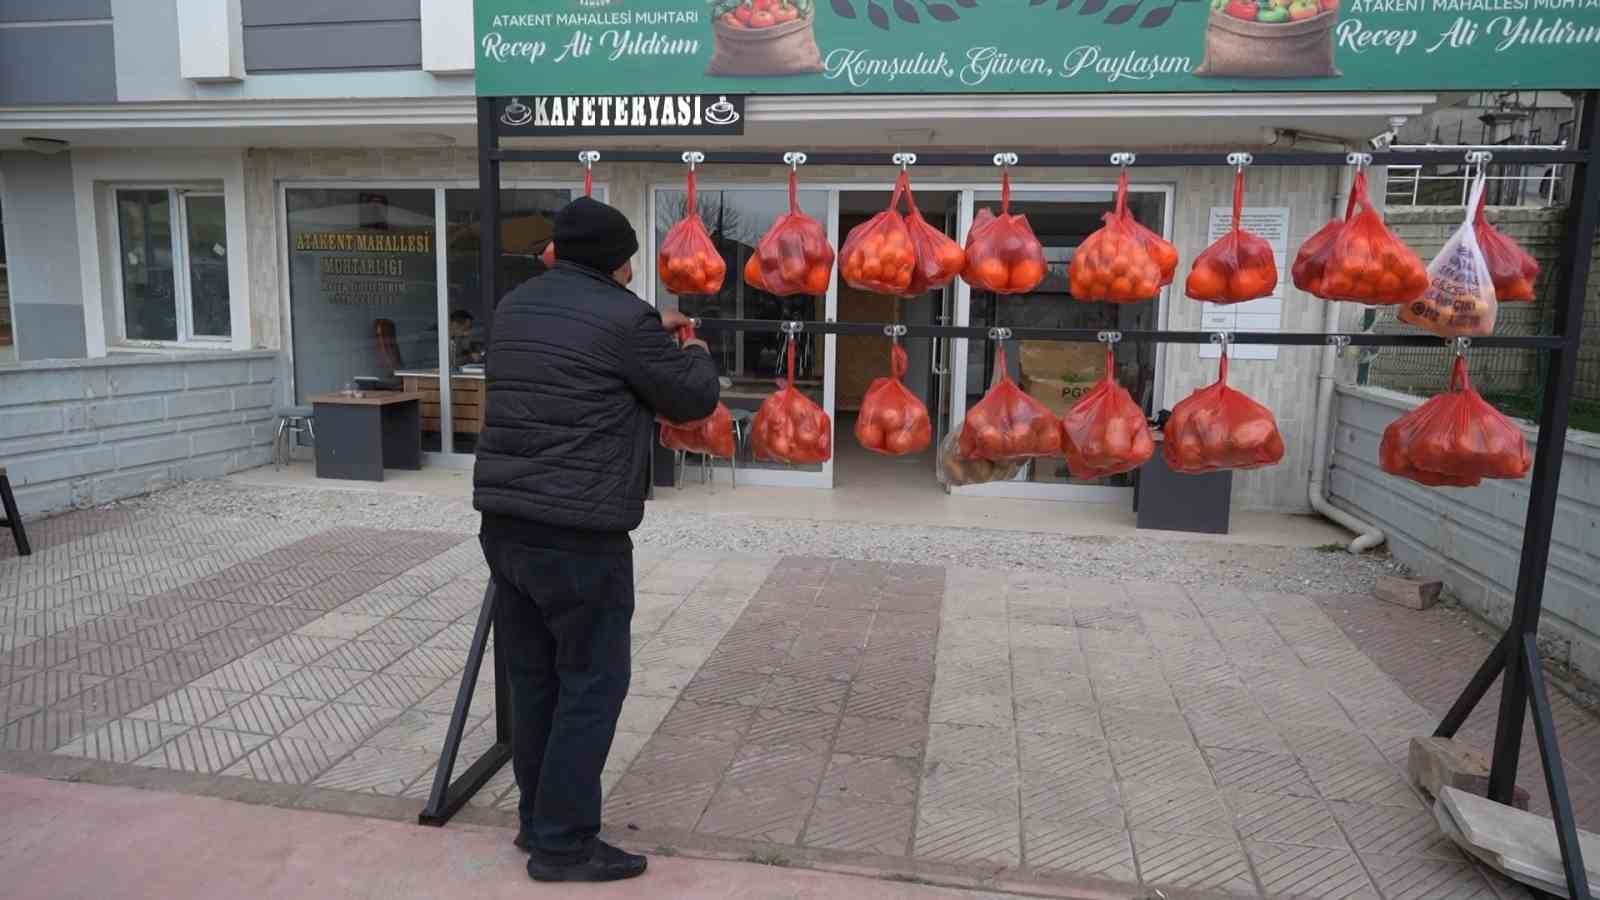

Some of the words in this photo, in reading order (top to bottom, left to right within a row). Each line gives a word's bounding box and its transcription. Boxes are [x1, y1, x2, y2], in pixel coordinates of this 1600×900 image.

[492, 14, 552, 27] ATAKENT
[556, 10, 632, 25] MAHALLESİ
[635, 11, 699, 24] MUHTARI
[1350, 0, 1426, 12] ATAKENT
[1534, 0, 1600, 9] MUHTA
[481, 32, 547, 64] Recep
[553, 30, 593, 63] Ali
[599, 29, 702, 61] Yıldırım
[1336, 18, 1418, 54] Recep
[1425, 16, 1479, 53] Ali
[823, 48, 954, 87] Komşuluk,
[960, 46, 1053, 86] Güven,
[1059, 45, 1193, 82] Paylaşım
[533, 95, 703, 126] KAFETERYASI
[297, 232, 353, 250] ATAKENT
[357, 231, 430, 252] MAHALLESİ
